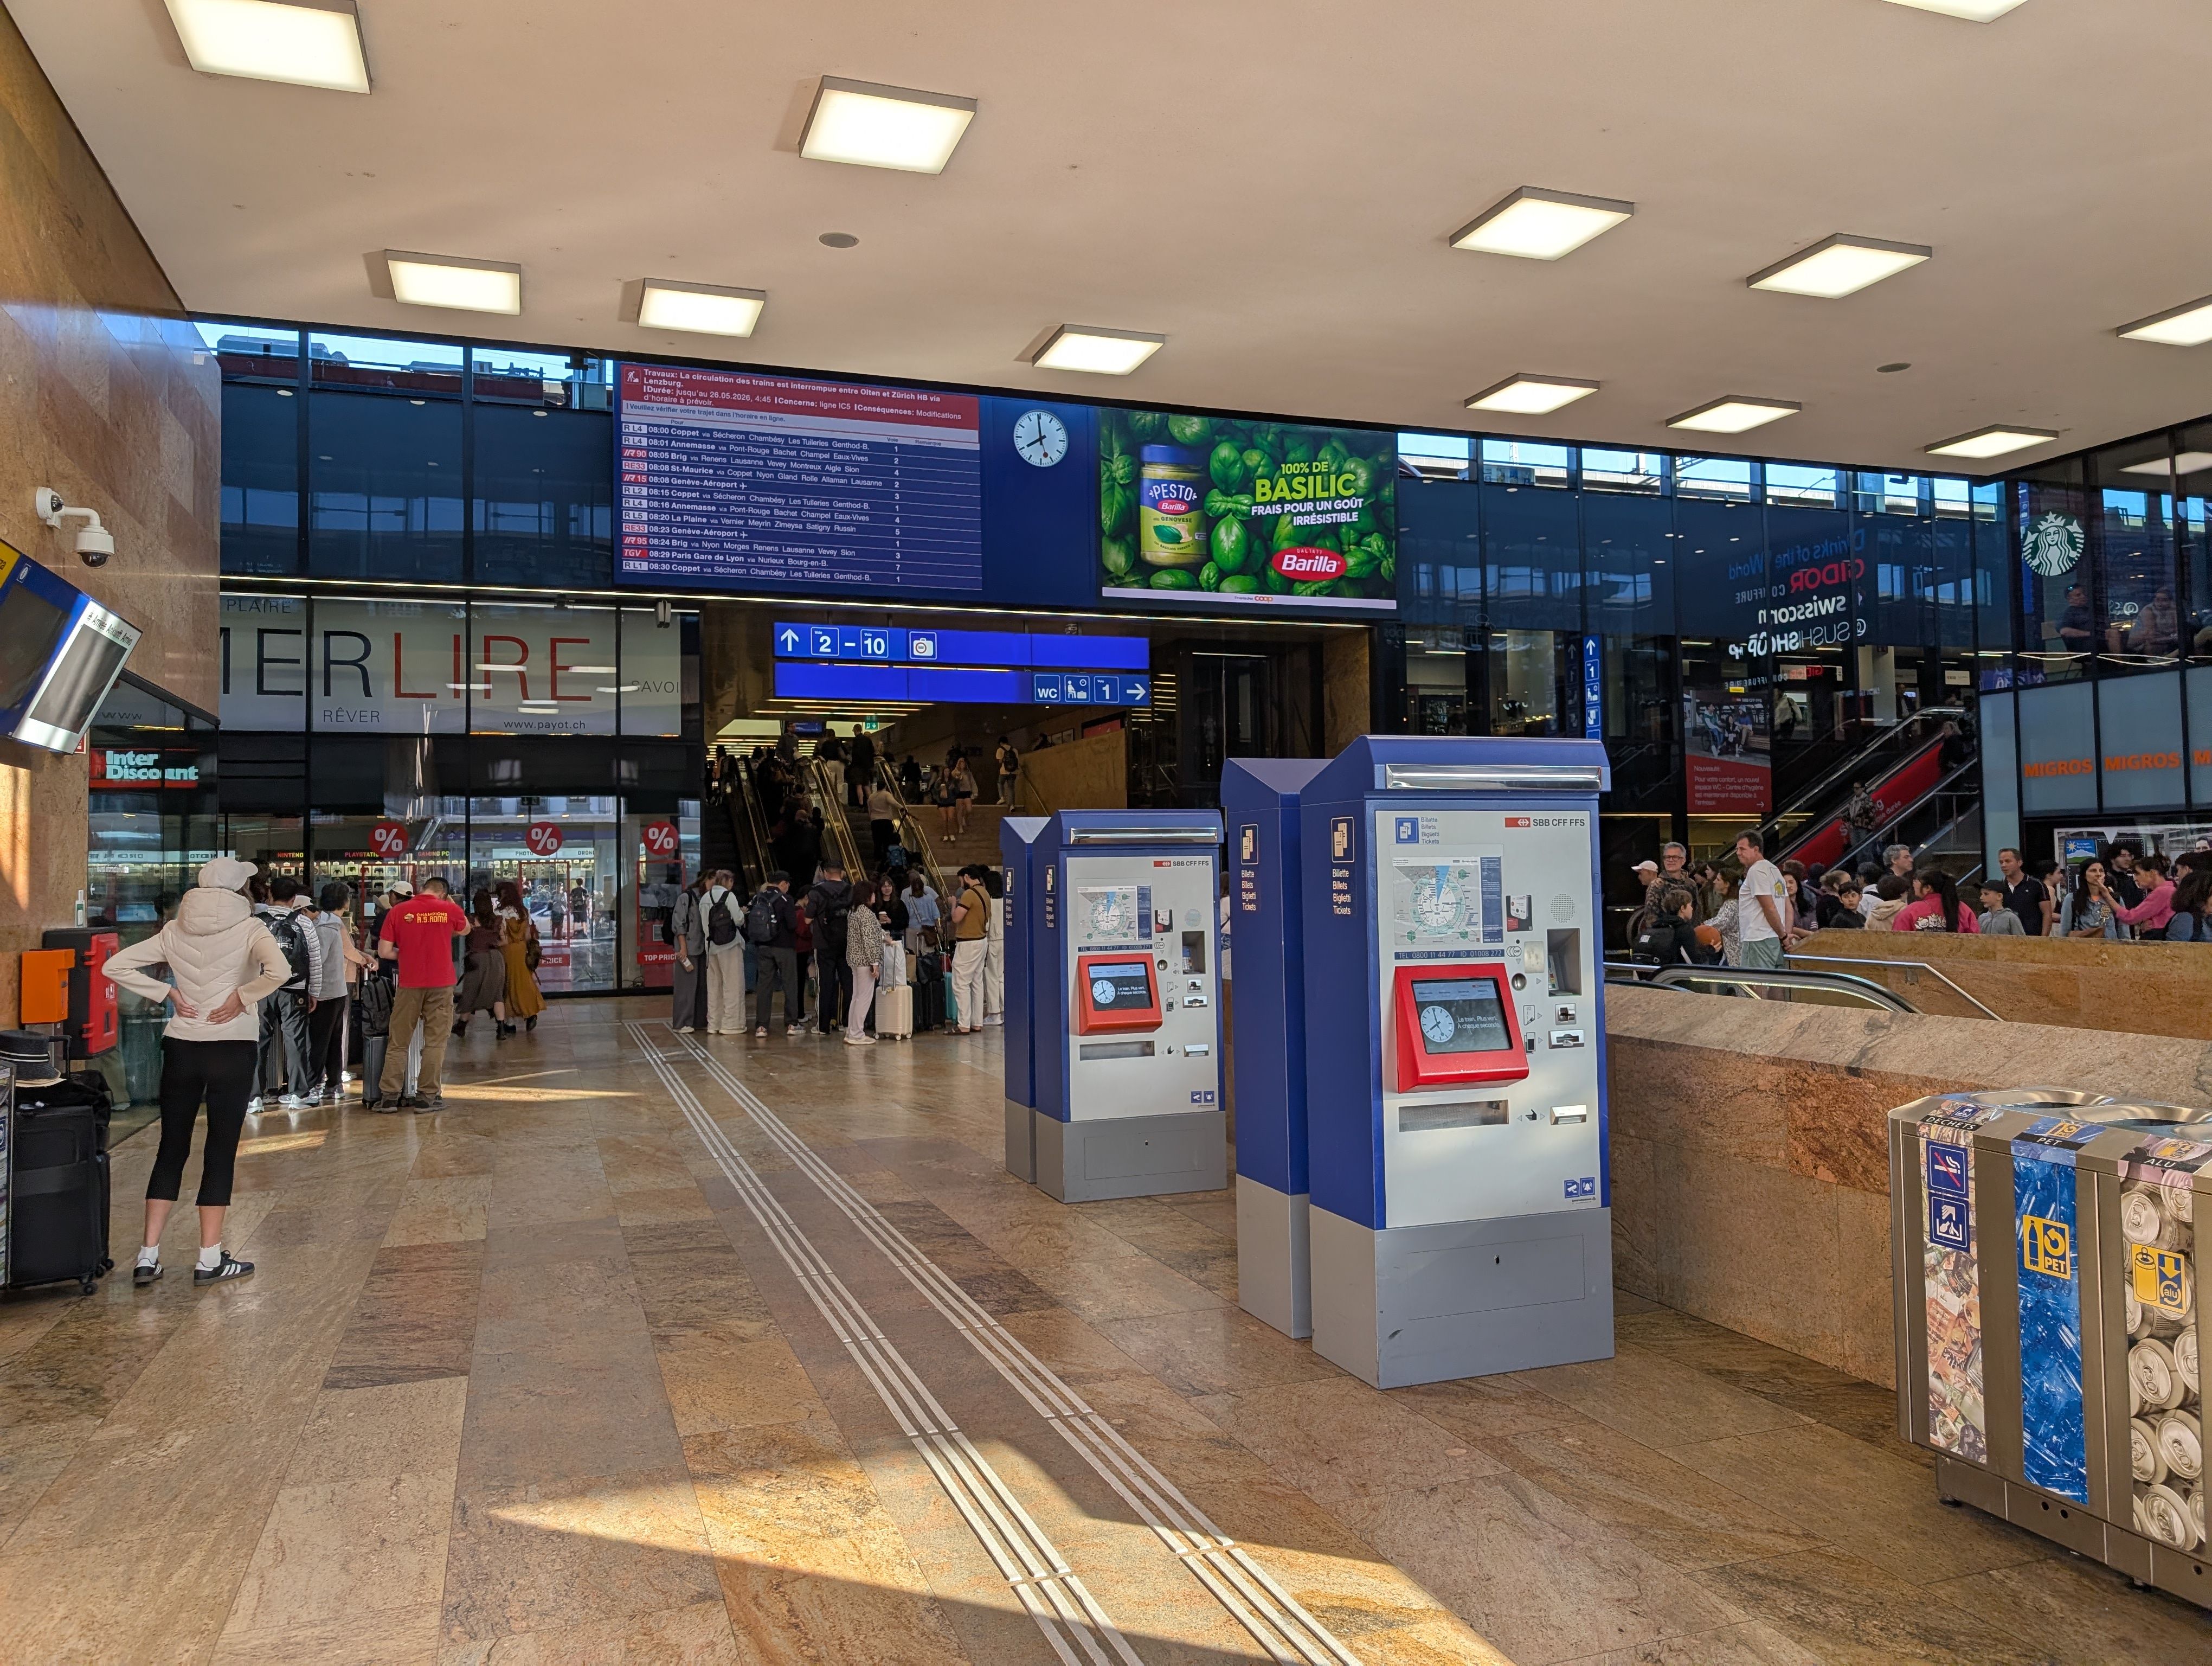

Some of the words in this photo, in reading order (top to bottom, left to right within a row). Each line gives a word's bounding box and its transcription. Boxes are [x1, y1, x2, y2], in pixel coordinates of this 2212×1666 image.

[643, 368, 677, 378] Travaux:
[691, 373, 734, 383] circulation
[752, 379, 775, 387] trains
[790, 382, 837, 393] interrompue
[860, 388, 880, 396] Olten
[891, 391, 915, 400] Zürich
[644, 376, 684, 388] Lenzburg.
[686, 396, 713, 406] prévoir.
[709, 390, 753, 402] 26.05.2026,
[755, 395, 771, 403] 4:45
[629, 403, 654, 411] Veuillez
[648, 438, 668, 446] 08:01
[670, 440, 716, 450] Annemasse
[729, 444, 769, 455] Pont-Rouge
[773, 447, 796, 456] Bachet
[800, 450, 829, 459] Champel
[833, 452, 869, 462] Eaux-Vives
[648, 451, 669, 459] 08:05
[671, 452, 687, 462] Brig
[700, 454, 726, 463] Renens
[730, 457, 763, 465] Lausanne
[767, 459, 787, 469] Vevey
[790, 461, 821, 470] Montreux
[824, 464, 841, 472] Aigle
[1281, 463, 1309, 475] 100%
[1313, 462, 1328, 472] DE
[623, 460, 645, 470] RE33
[648, 463, 670, 471] 08:08
[670, 464, 713, 474] St-Maurice
[726, 469, 753, 478] Coppet
[756, 471, 774, 479] Nyon
[777, 472, 798, 480] Gland
[821, 476, 847, 484] Allaman
[851, 478, 882, 486] Lausanne
[636, 475, 646, 483] 15
[671, 477, 737, 488] Genève-Aéroport
[1256, 473, 1356, 502] BASILIC
[1153, 484, 1193, 501] PESTO
[1161, 503, 1185, 511] Barilla
[1251, 504, 1282, 516] FRAIS
[1284, 502, 1314, 513] POUR
[1316, 501, 1332, 511] UN
[1334, 497, 1364, 510] GOÛT
[1293, 511, 1358, 526] IRRÉSISTIBLE
[624, 548, 641, 556] TGV
[671, 551, 691, 559] Paris
[725, 554, 744, 562] Lyon
[758, 556, 784, 564] Nurieux
[787, 558, 828, 567] Bourg-en-B.
[1282, 554, 1337, 573] Barilla
[227, 599, 291, 613] PLAIRE
[819, 636, 831, 652] 2
[864, 638, 885, 655] 10
[394, 632, 591, 702] LIRE
[1590, 666, 1594, 678] 1
[1038, 688, 1058, 699] WC
[1102, 684, 1110, 700] 1
[323, 707, 380, 723] RÊVER
[504, 720, 586, 731] www.payot.ch
[106, 751, 158, 765] Inter
[2105, 752, 2181, 772] MIGROS
[106, 765, 199, 780] Discount
[2024, 758, 2093, 778] MIGROS
[1552, 818, 1568, 826] CFF
[375, 828, 403, 852] %
[531, 828, 557, 850] %
[648, 828, 673, 849] %
[1332, 868, 1349, 877] Billette
[1333, 881, 1347, 890] Billets
[1333, 893, 1351, 904] Biglietti
[1333, 905, 1351, 914] Tickets
[1925, 1116, 1977, 1131] DECHETS
[2037, 1137, 2062, 1146] PET
[2144, 1157, 2177, 1169] ALU
[2045, 1256, 2066, 1273] PET
[2164, 1288, 2178, 1299] alu
